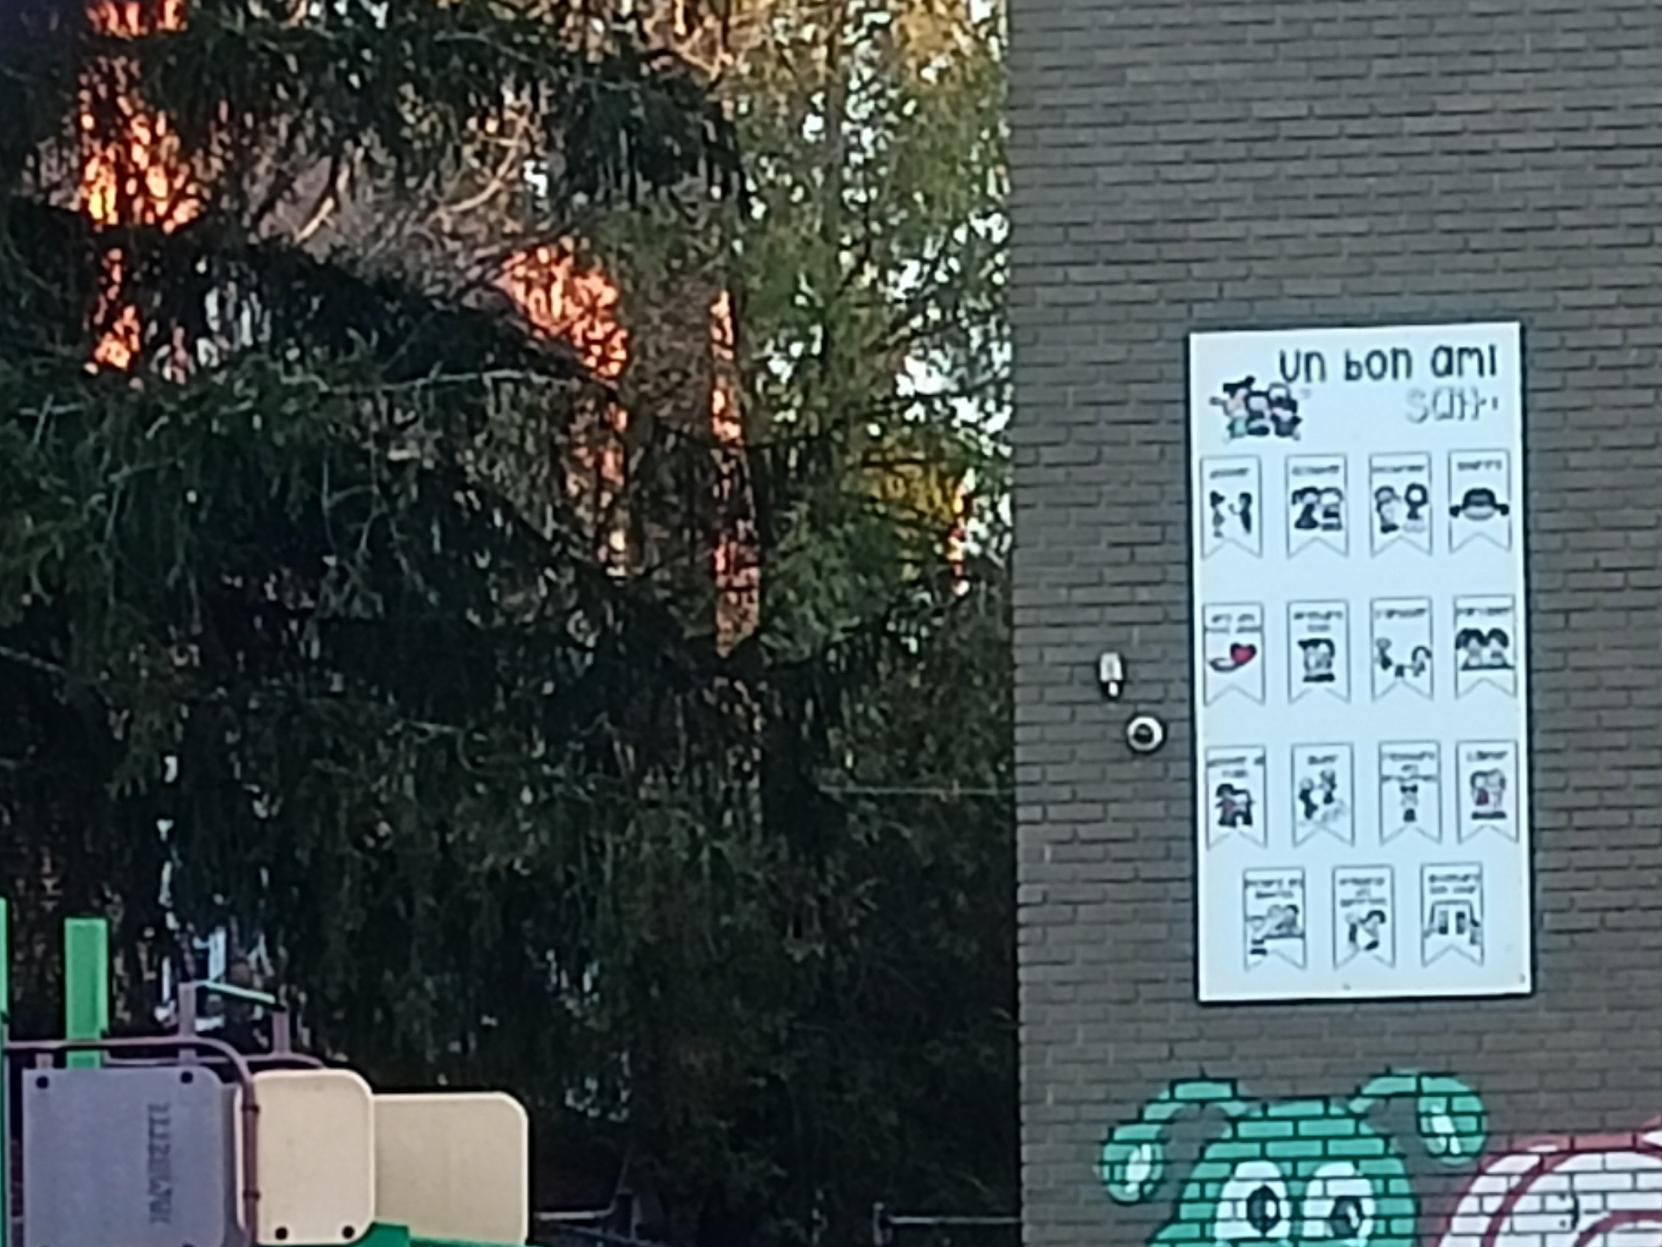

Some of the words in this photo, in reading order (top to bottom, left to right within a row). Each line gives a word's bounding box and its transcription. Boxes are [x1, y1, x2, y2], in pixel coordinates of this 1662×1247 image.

[1279, 349, 1327, 384] Un
[1344, 346, 1413, 381] bon
[1431, 344, 1498, 378] ami
